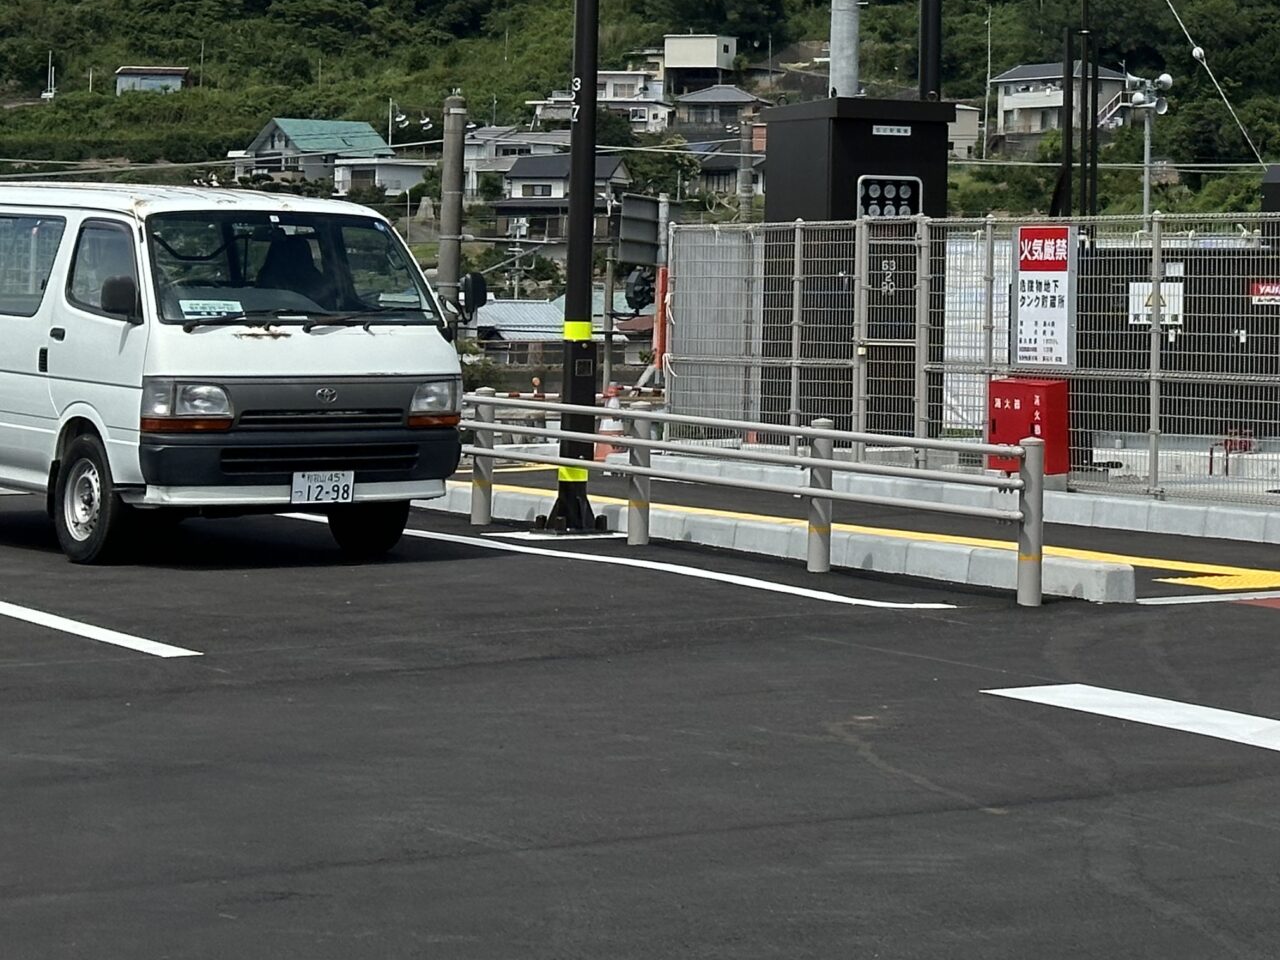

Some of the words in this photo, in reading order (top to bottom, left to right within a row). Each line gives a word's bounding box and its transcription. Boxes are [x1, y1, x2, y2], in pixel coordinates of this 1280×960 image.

[1020, 239, 1067, 260] 火気厳禁
[1020, 279, 1059, 293] 危険物地下
[1020, 294, 1065, 308] タンク貯蔵所
[328, 472, 340, 482] 45
[307, 483, 350, 501] 12-98
